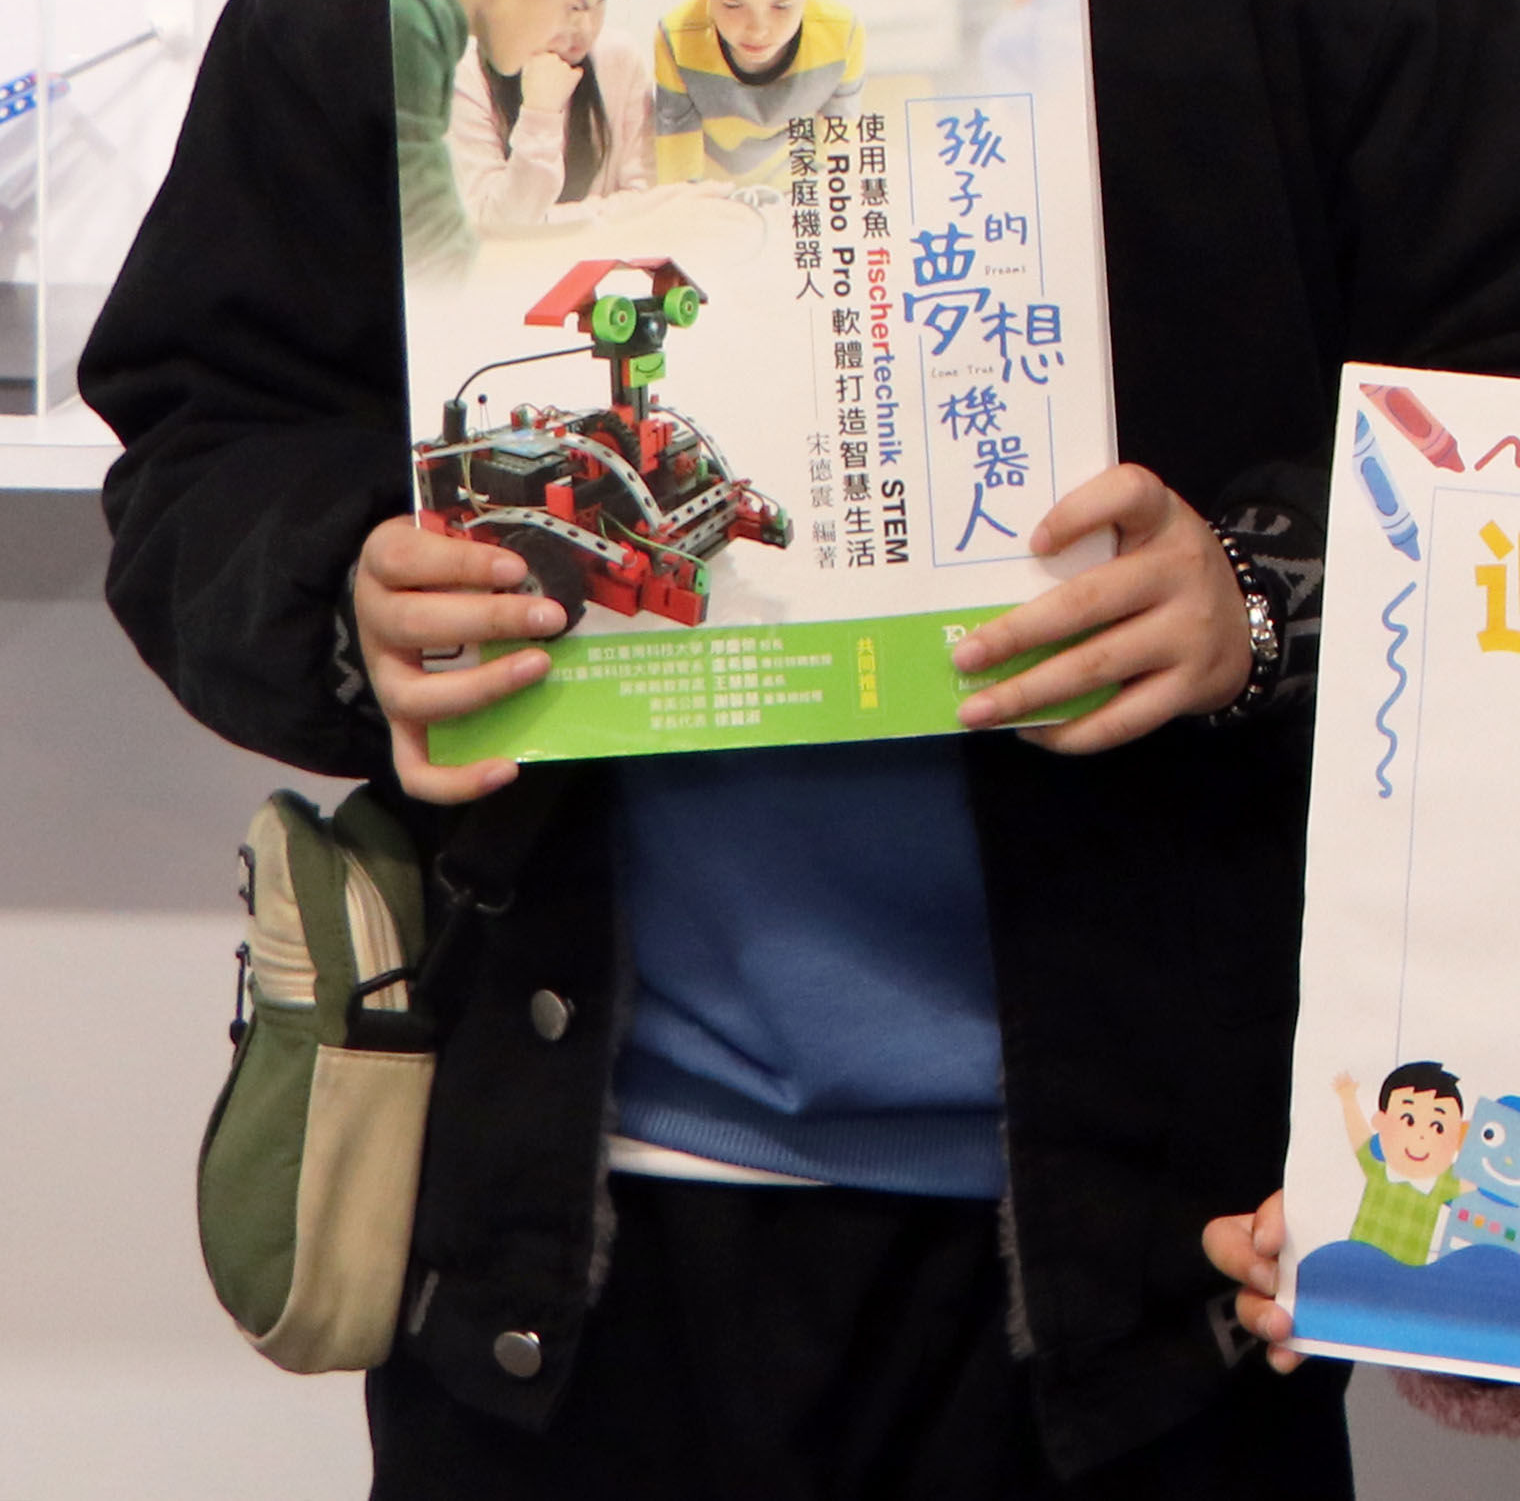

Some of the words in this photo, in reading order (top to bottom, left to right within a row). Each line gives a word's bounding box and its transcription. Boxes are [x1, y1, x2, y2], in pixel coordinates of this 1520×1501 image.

[822, 115, 849, 145] 及
[856, 113, 892, 240] 使用慧魚
[785, 116, 825, 301] 與家庭機器人
[826, 153, 855, 232] Robo
[831, 247, 856, 298] Pro
[865, 247, 904, 466] fischertechnik
[831, 307, 876, 569] 軟體打造智慧生活
[881, 478, 910, 565] STEM
